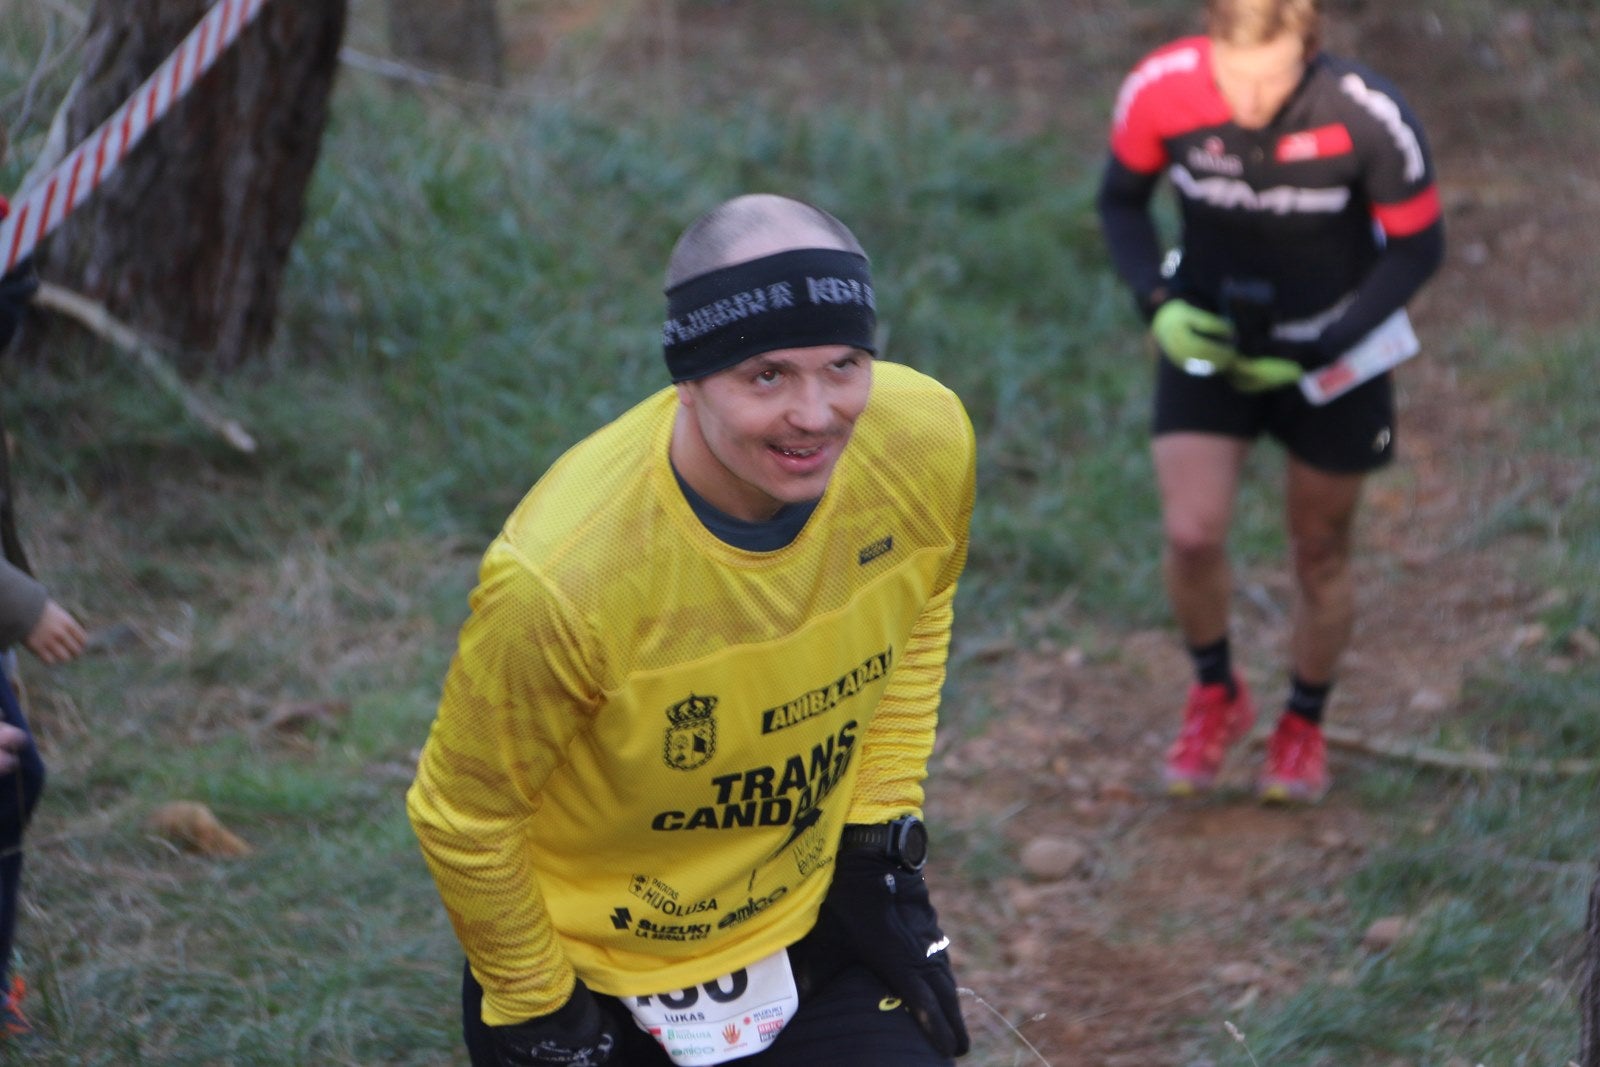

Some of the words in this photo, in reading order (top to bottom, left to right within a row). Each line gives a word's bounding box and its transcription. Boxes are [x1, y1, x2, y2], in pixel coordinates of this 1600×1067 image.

[711, 719, 858, 805] TRANS
[641, 886, 718, 917] HIJOLUSA
[638, 918, 711, 935] SUZUKI
[665, 1011, 706, 1023] LUKAS
